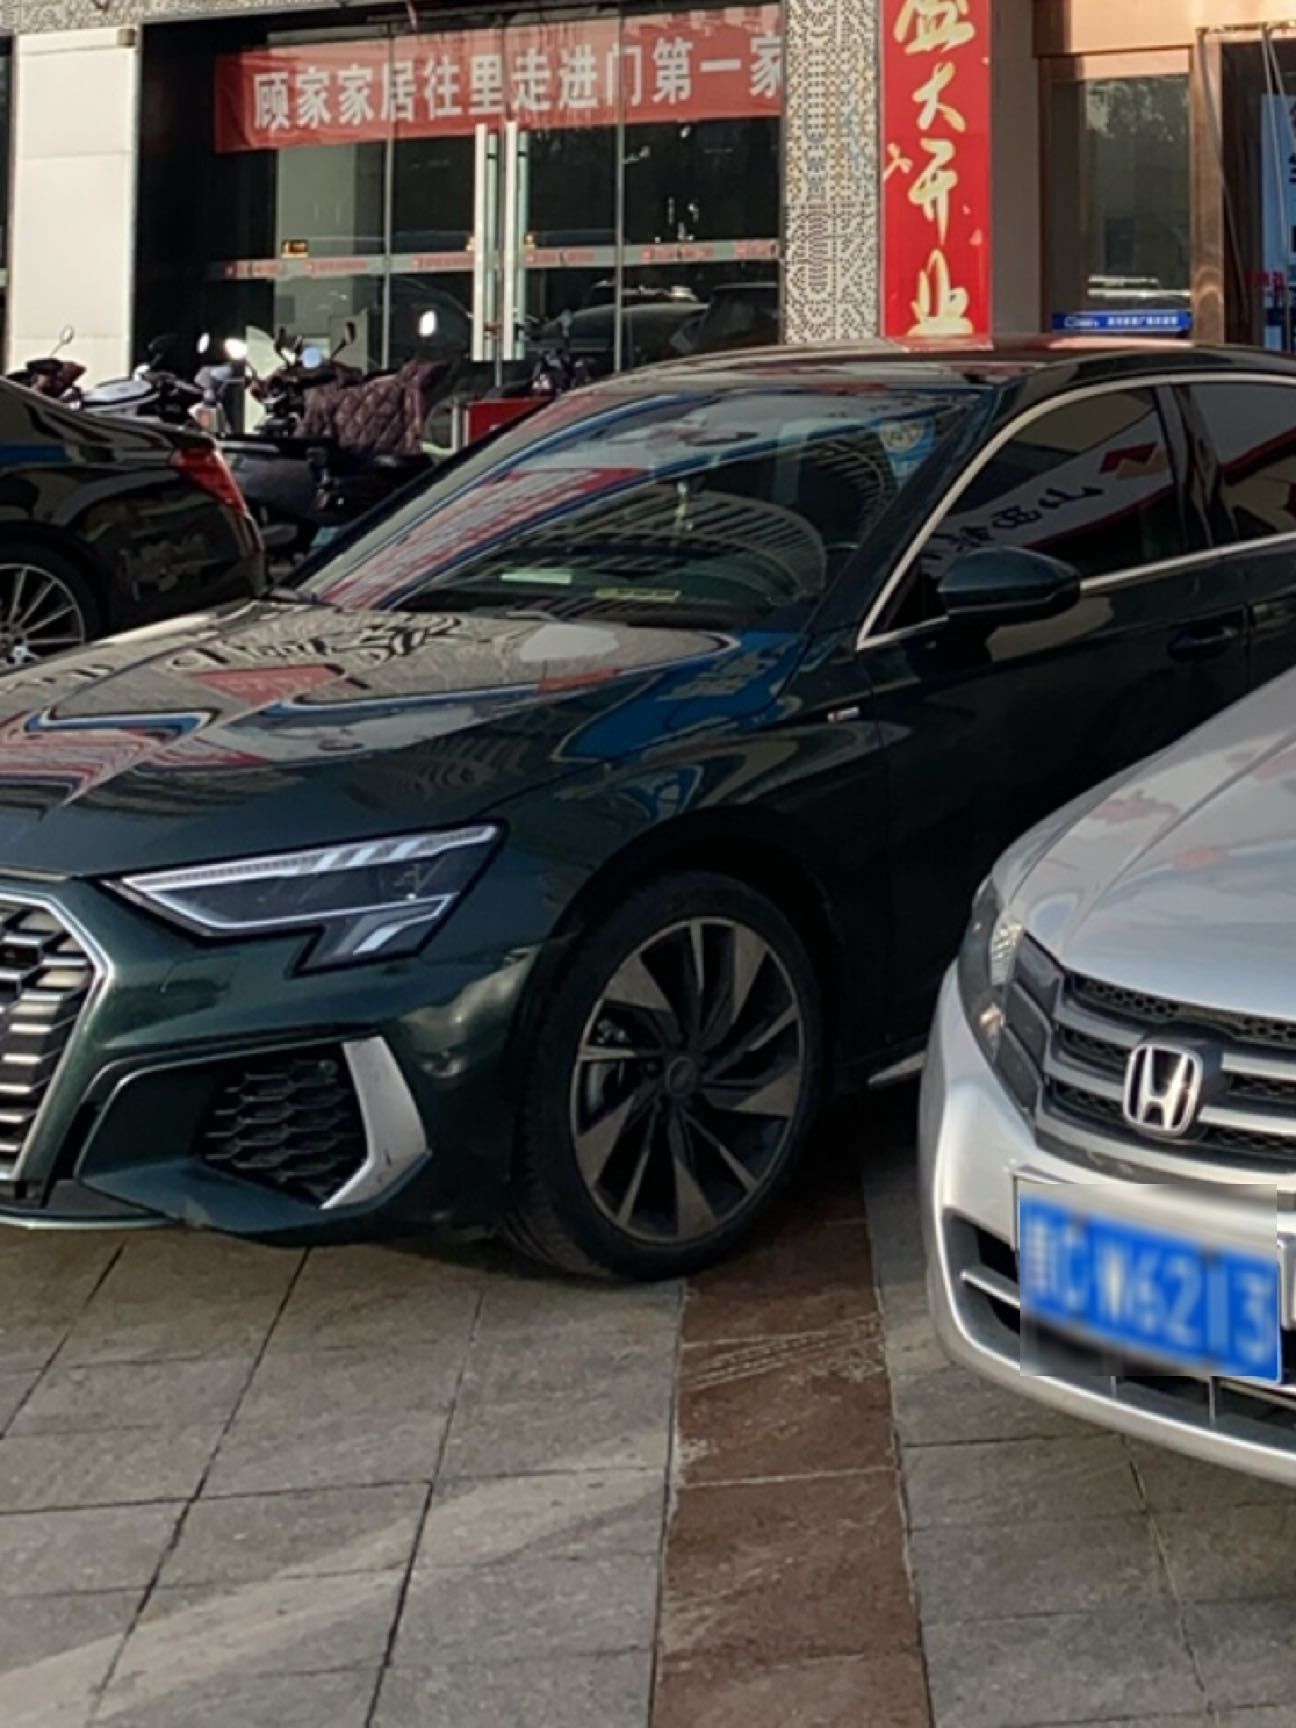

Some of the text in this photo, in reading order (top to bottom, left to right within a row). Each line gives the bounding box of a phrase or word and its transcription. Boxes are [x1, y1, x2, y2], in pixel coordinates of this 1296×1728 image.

[252, 30, 784, 130] 顾家家居往里走进门第一家
